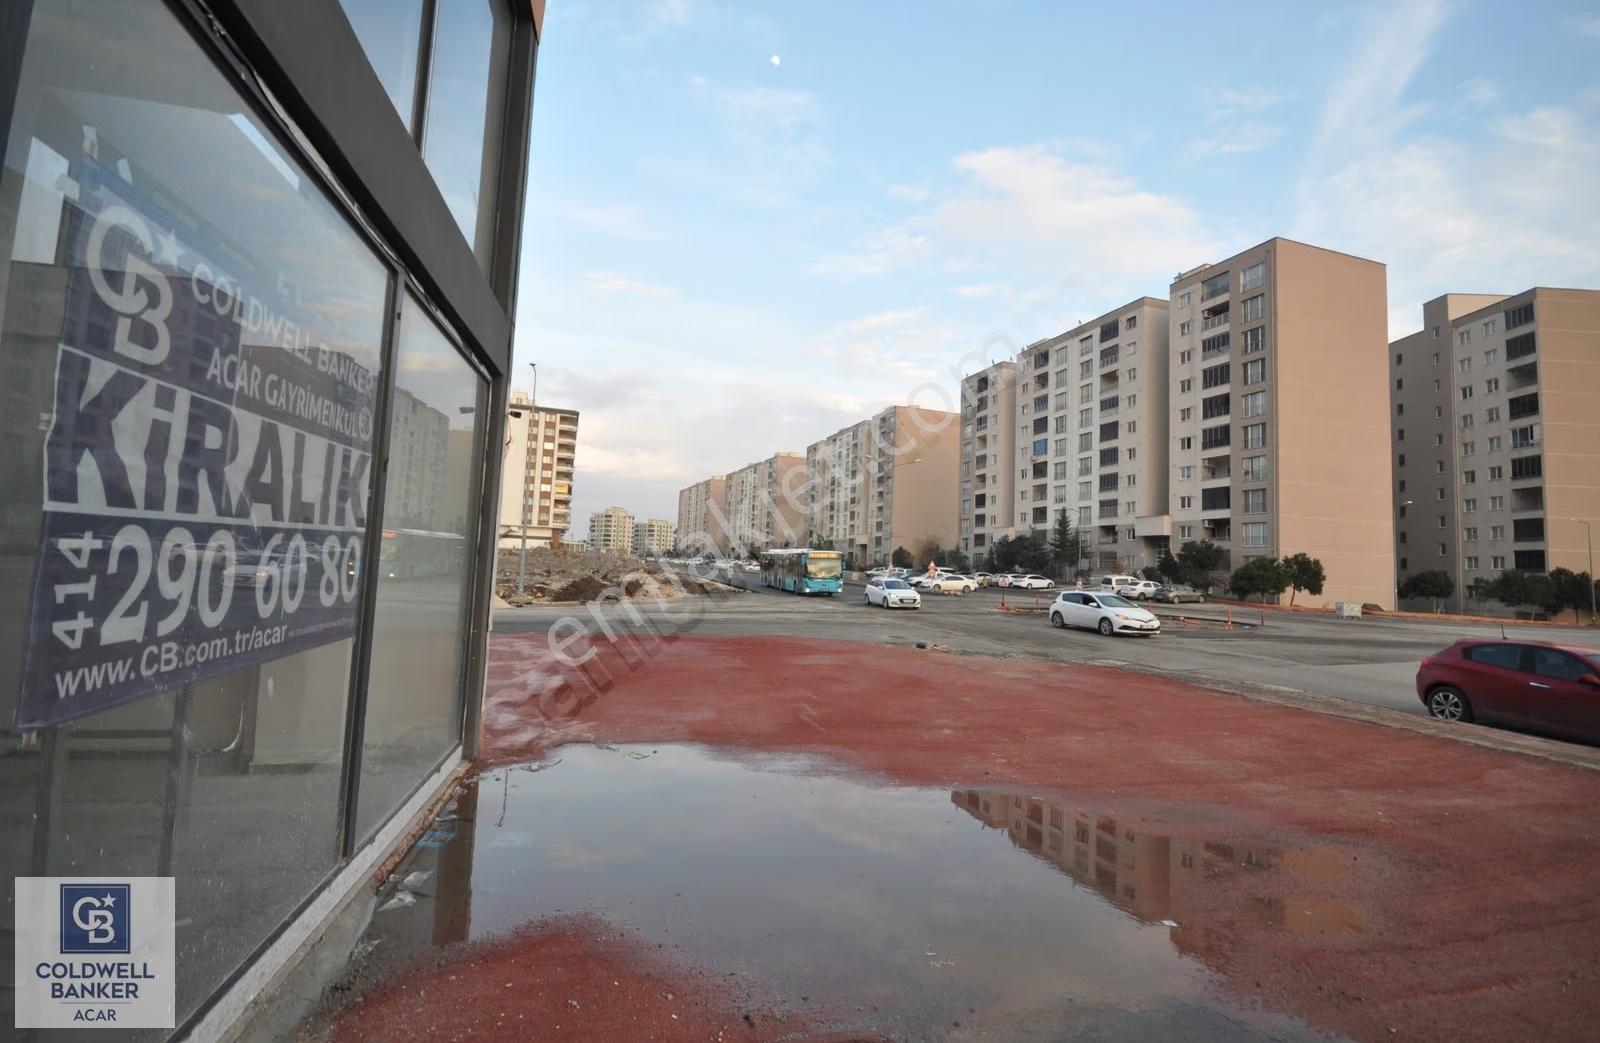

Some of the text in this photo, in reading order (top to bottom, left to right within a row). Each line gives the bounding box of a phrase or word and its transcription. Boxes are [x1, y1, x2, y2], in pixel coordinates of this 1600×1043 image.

[85, 205, 173, 366] CB
[192, 263, 375, 398] COLDWELL BANKER
[206, 347, 261, 400] ACAR
[52, 531, 103, 649] 414
[100, 524, 361, 646] 290 60 80
[55, 624, 288, 698] www.CB.com.tr/acar
